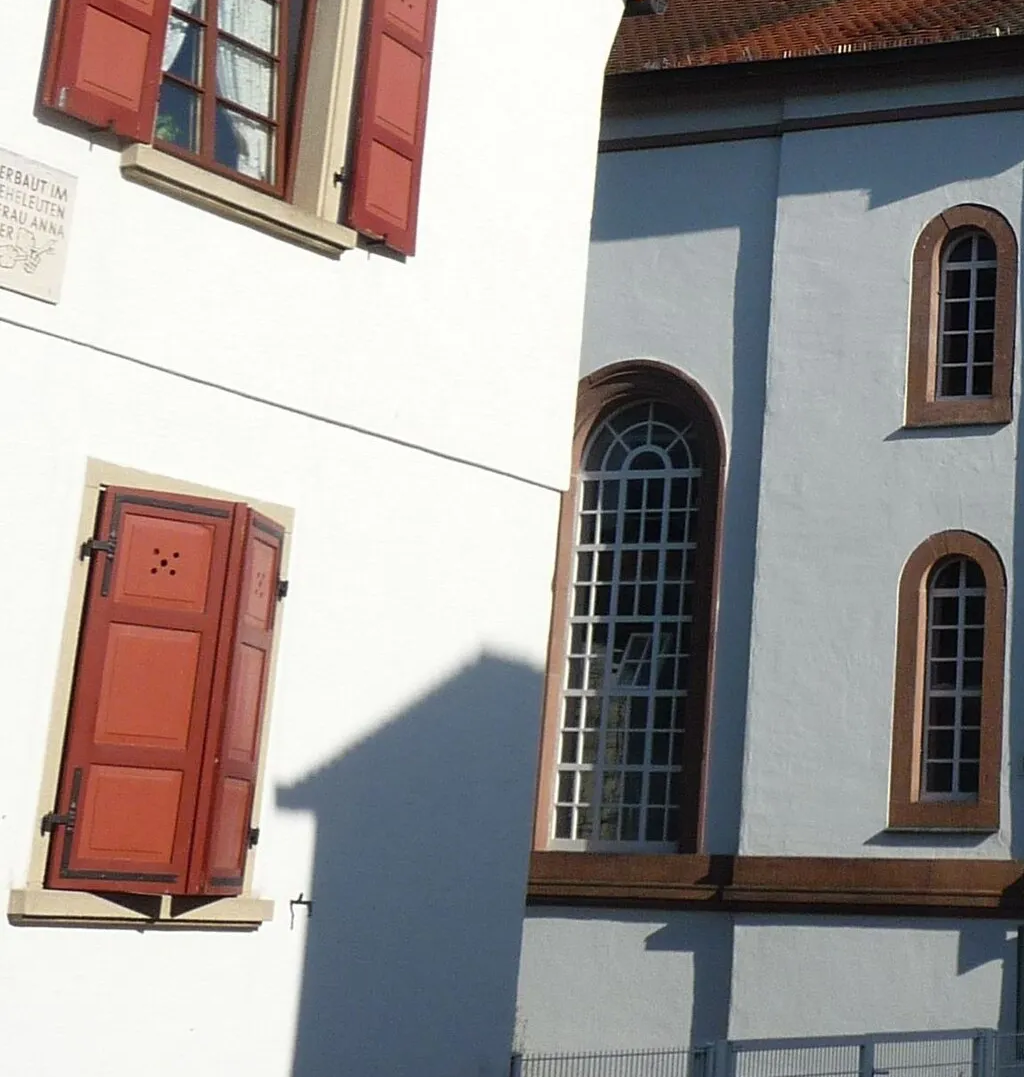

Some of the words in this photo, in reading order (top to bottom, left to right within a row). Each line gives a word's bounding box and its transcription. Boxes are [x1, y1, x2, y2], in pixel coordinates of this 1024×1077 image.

[0, 165, 48, 194] ERBAUT
[50, 184, 68, 202] IM
[0, 184, 65, 219] EHELEUTEN
[31, 216, 65, 239] ANNA
